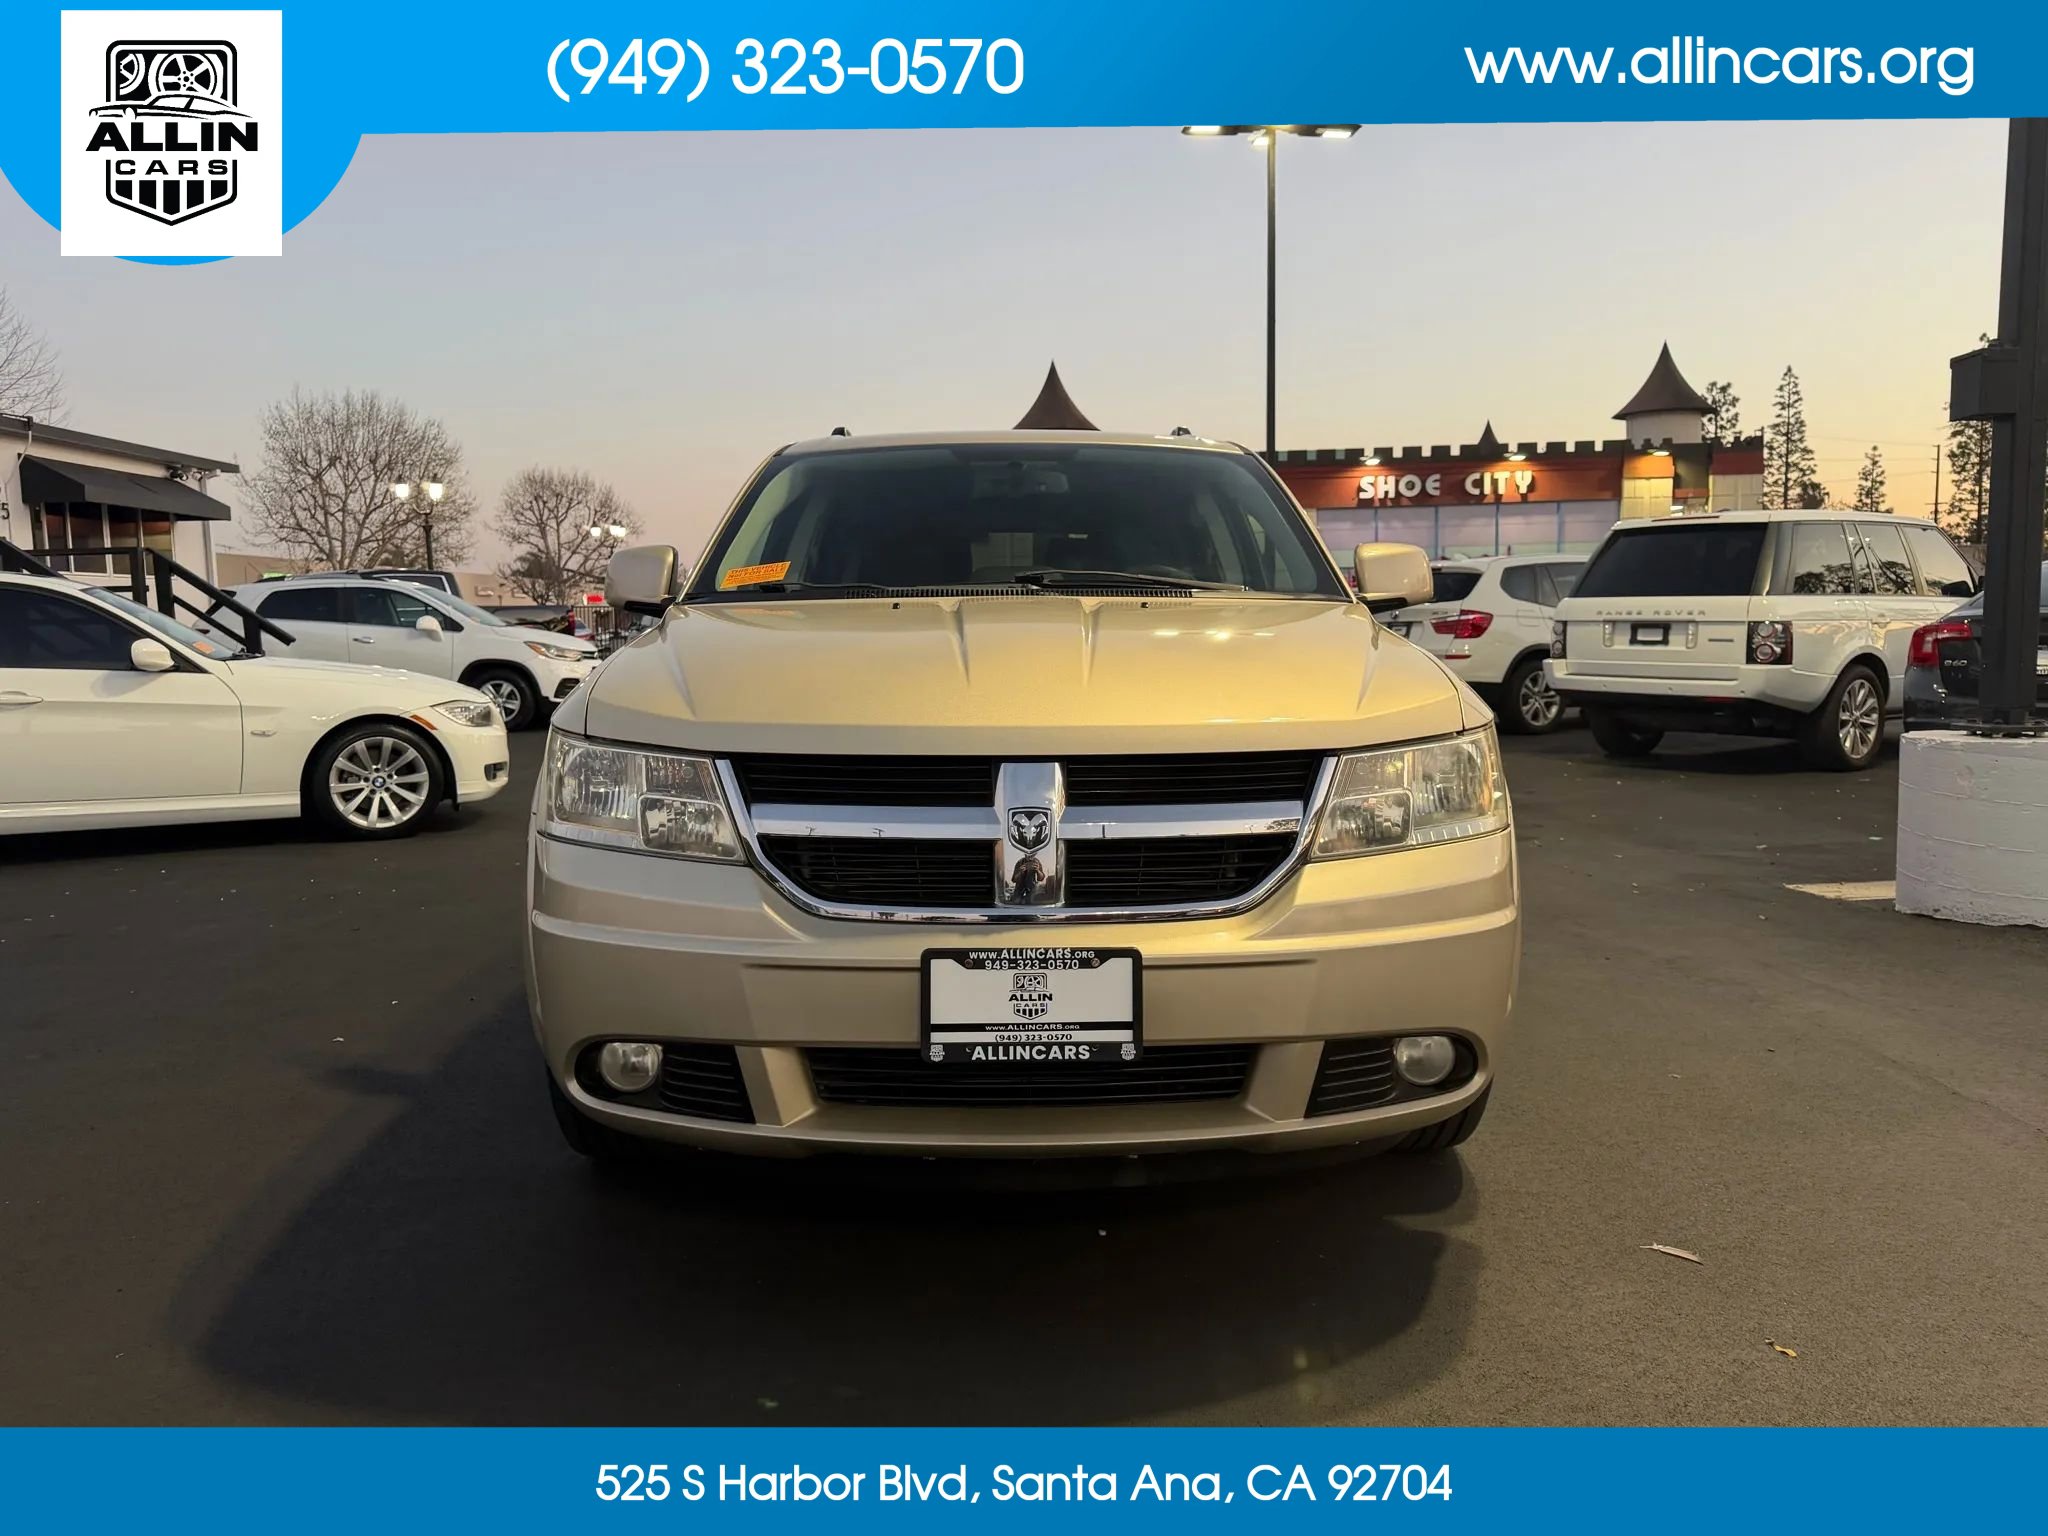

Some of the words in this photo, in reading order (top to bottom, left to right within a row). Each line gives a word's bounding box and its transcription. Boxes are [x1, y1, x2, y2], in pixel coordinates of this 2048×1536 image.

[1359, 473, 1441, 499] SHOE
[1464, 470, 1534, 496] CITY
[984, 959, 1080, 971] 949-323-0570
[1008, 993, 1053, 1002] ALLIN
[995, 1033, 1022, 1042] (949)
[1025, 1033, 1073, 1041] 323-0570
[971, 1045, 1091, 1061] ALLINCARS
